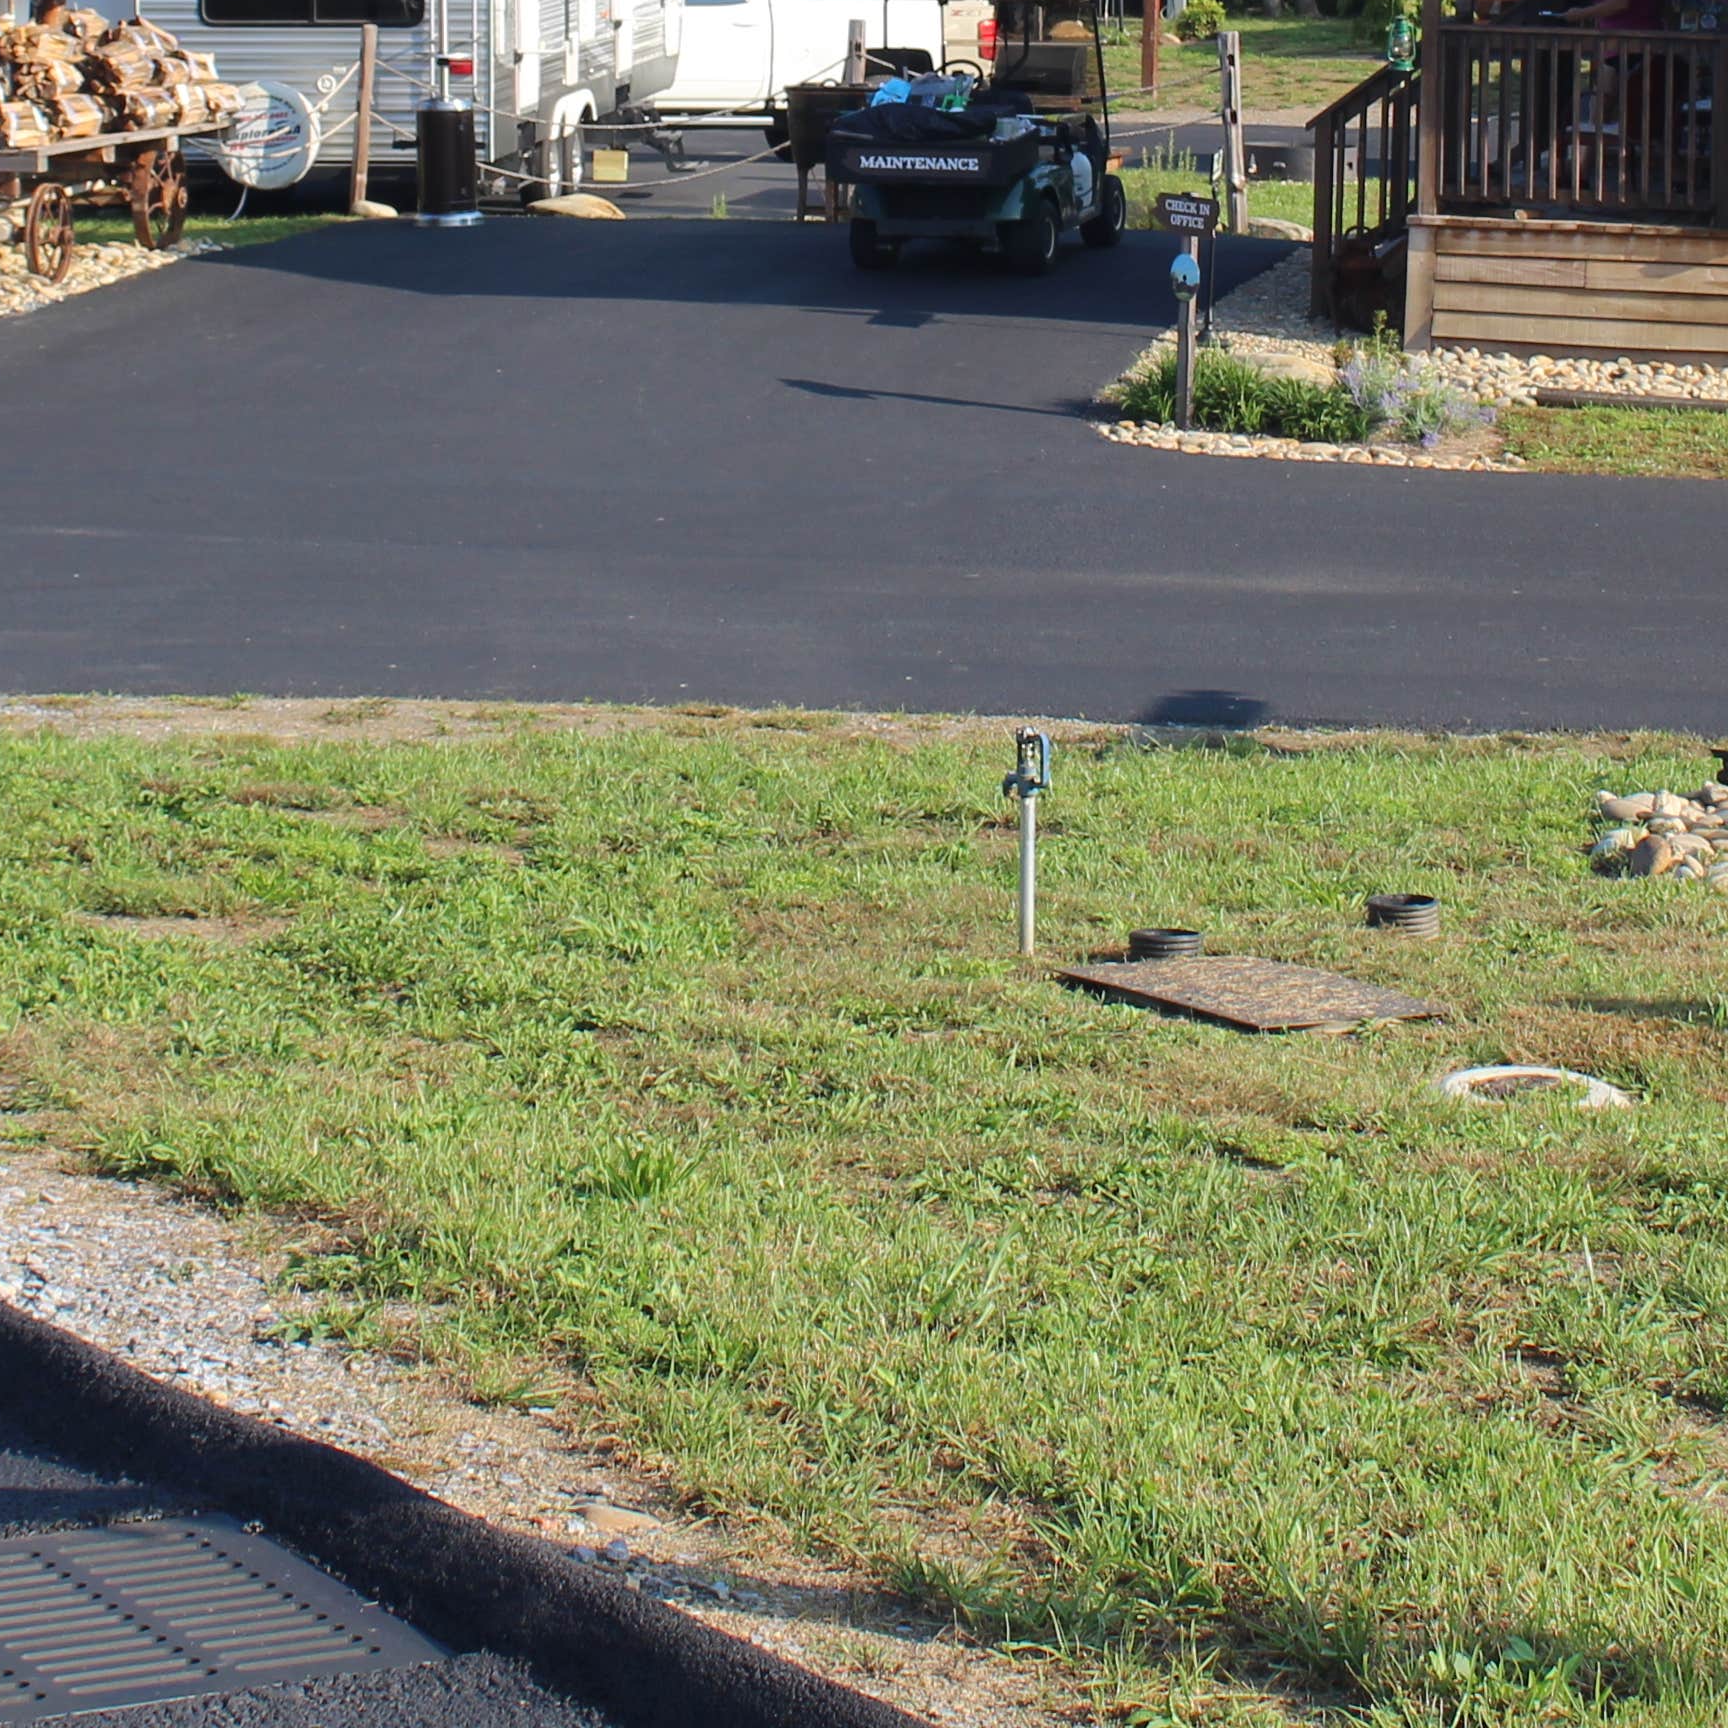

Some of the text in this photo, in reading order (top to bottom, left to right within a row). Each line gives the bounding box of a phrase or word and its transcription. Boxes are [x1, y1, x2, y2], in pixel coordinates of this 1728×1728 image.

[859, 155, 979, 171] MAINTENANCE
[1165, 199, 1211, 217] CHECK IN
[1170, 213, 1204, 230] OFFICE
